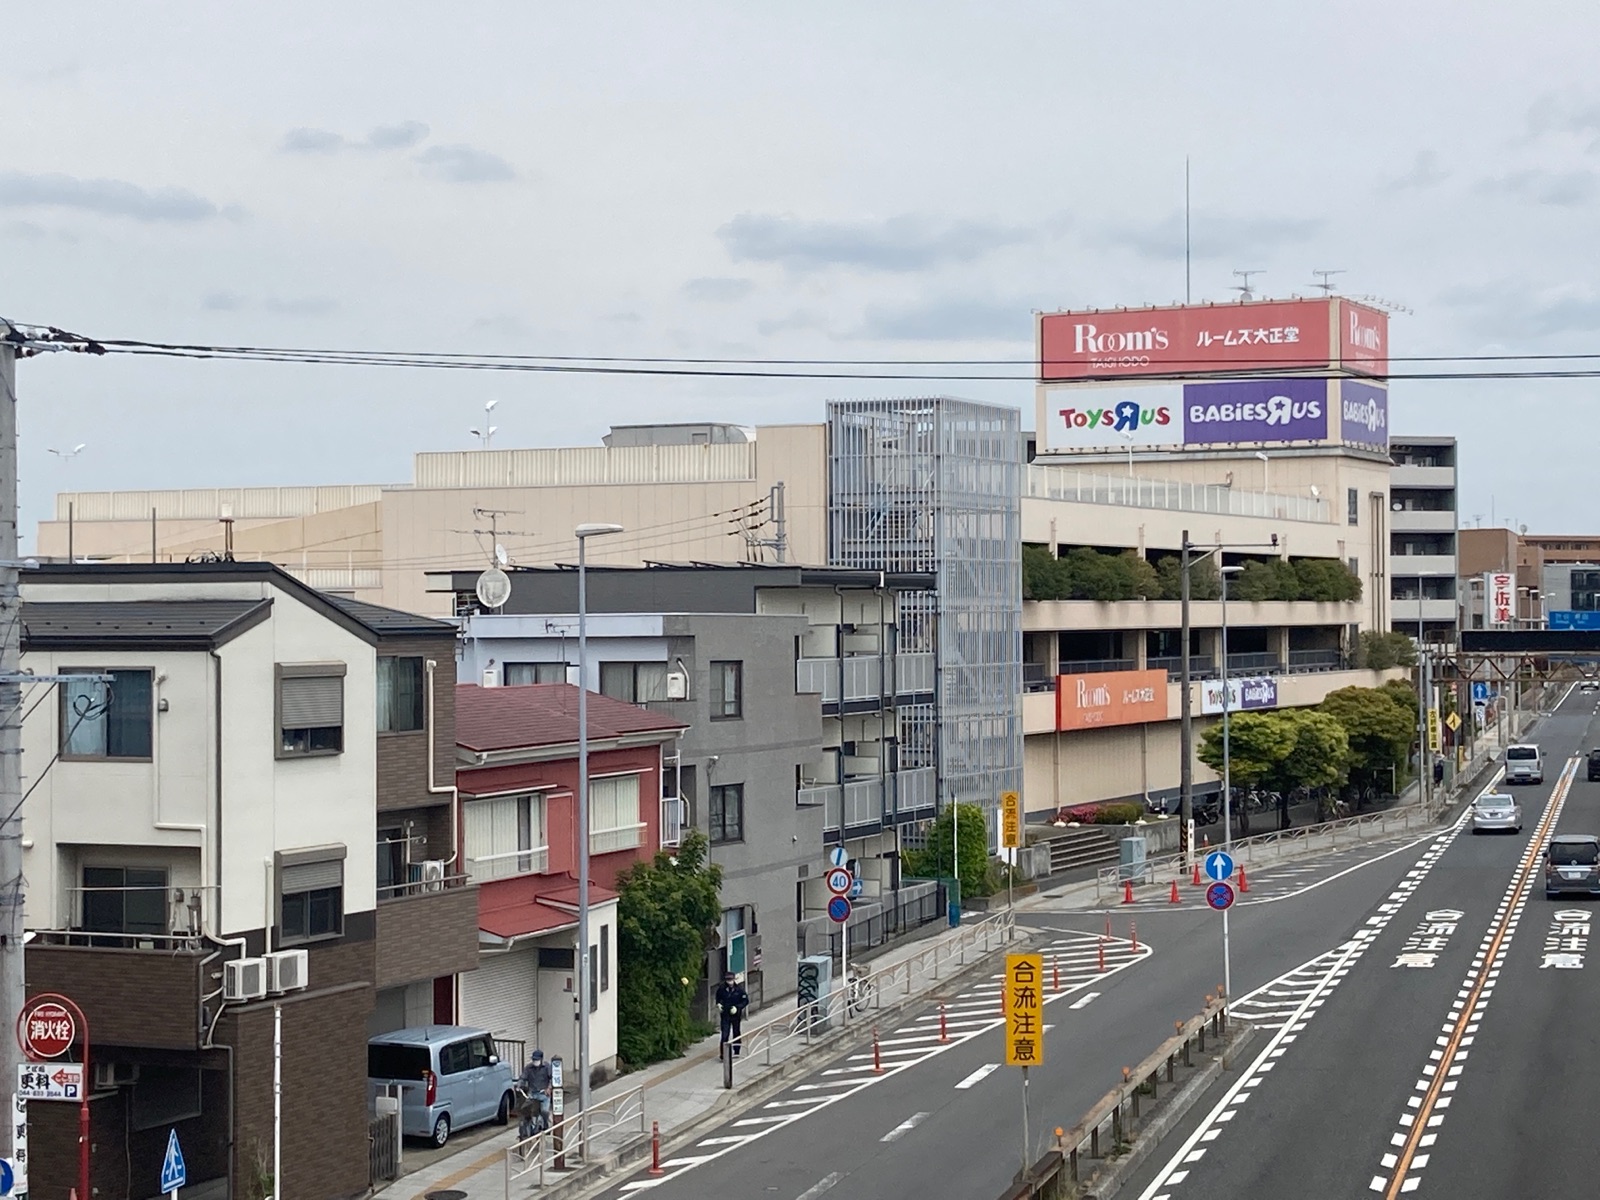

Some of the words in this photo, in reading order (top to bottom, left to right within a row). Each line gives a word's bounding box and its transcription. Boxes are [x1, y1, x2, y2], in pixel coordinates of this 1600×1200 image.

[1073, 323, 1168, 355] Room's
[1197, 327, 1299, 348] ルームズ大正堂
[1005, 794, 1017, 845] 合流注意
[832, 875, 847, 888] 40
[1012, 960, 1036, 1062] 合流注意
[31, 1020, 70, 1041] 消火栓
[20, 1073, 50, 1090] 更科
